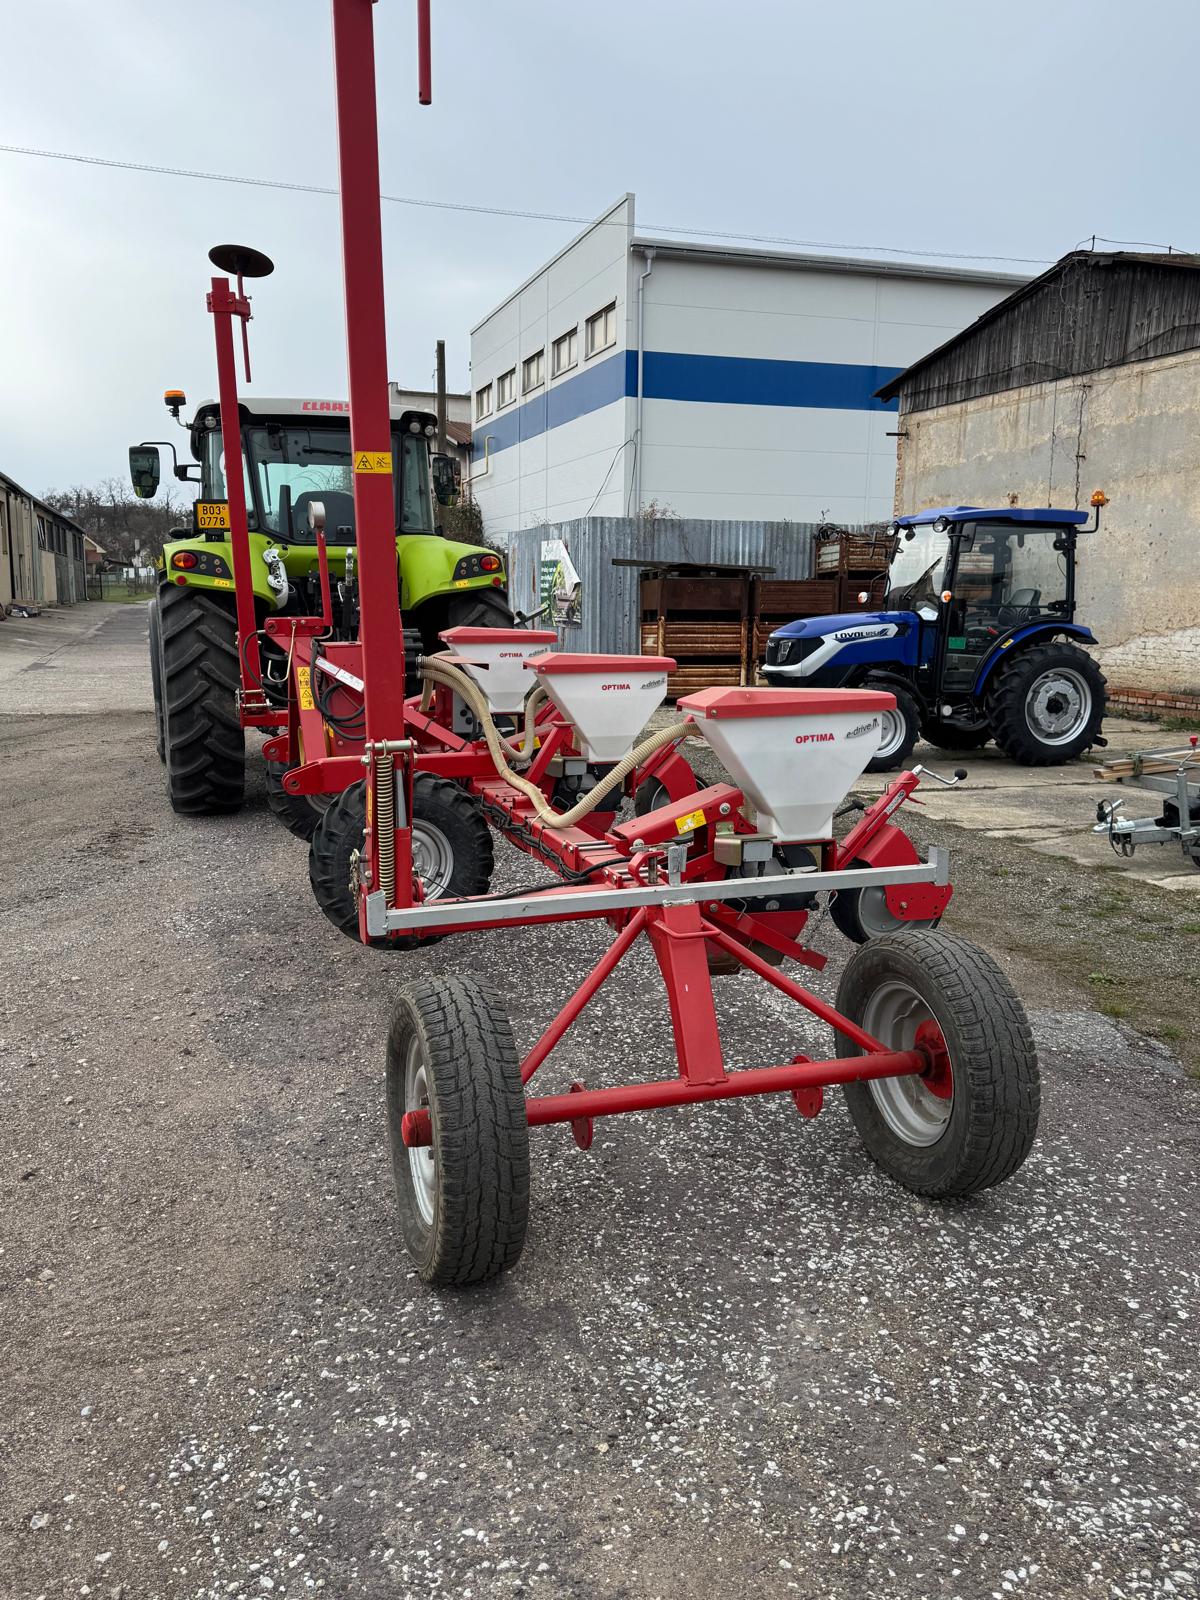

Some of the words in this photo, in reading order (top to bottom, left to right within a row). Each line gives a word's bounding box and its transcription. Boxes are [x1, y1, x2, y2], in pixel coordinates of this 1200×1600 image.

[200, 517, 225, 526] 0778
[834, 631, 865, 639] LOVOL
[601, 683, 631, 691] OPTIMA
[795, 733, 835, 744] OPTIMA
[846, 723, 872, 738] e-drive
